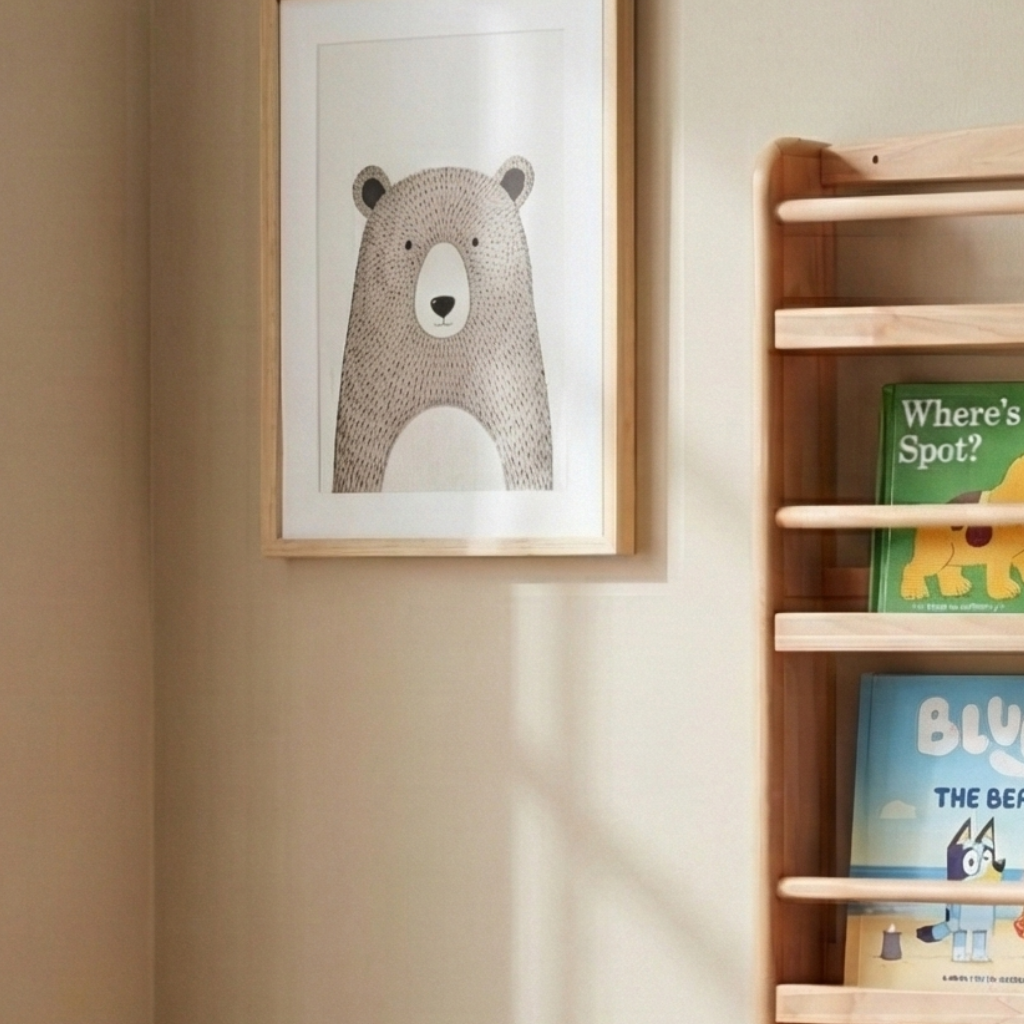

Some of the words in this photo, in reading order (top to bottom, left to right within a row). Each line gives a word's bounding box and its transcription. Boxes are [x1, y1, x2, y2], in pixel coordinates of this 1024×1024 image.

[901, 397, 1021, 428] Where's
[898, 433, 982, 470] Spot?
[934, 787, 980, 808] THE
